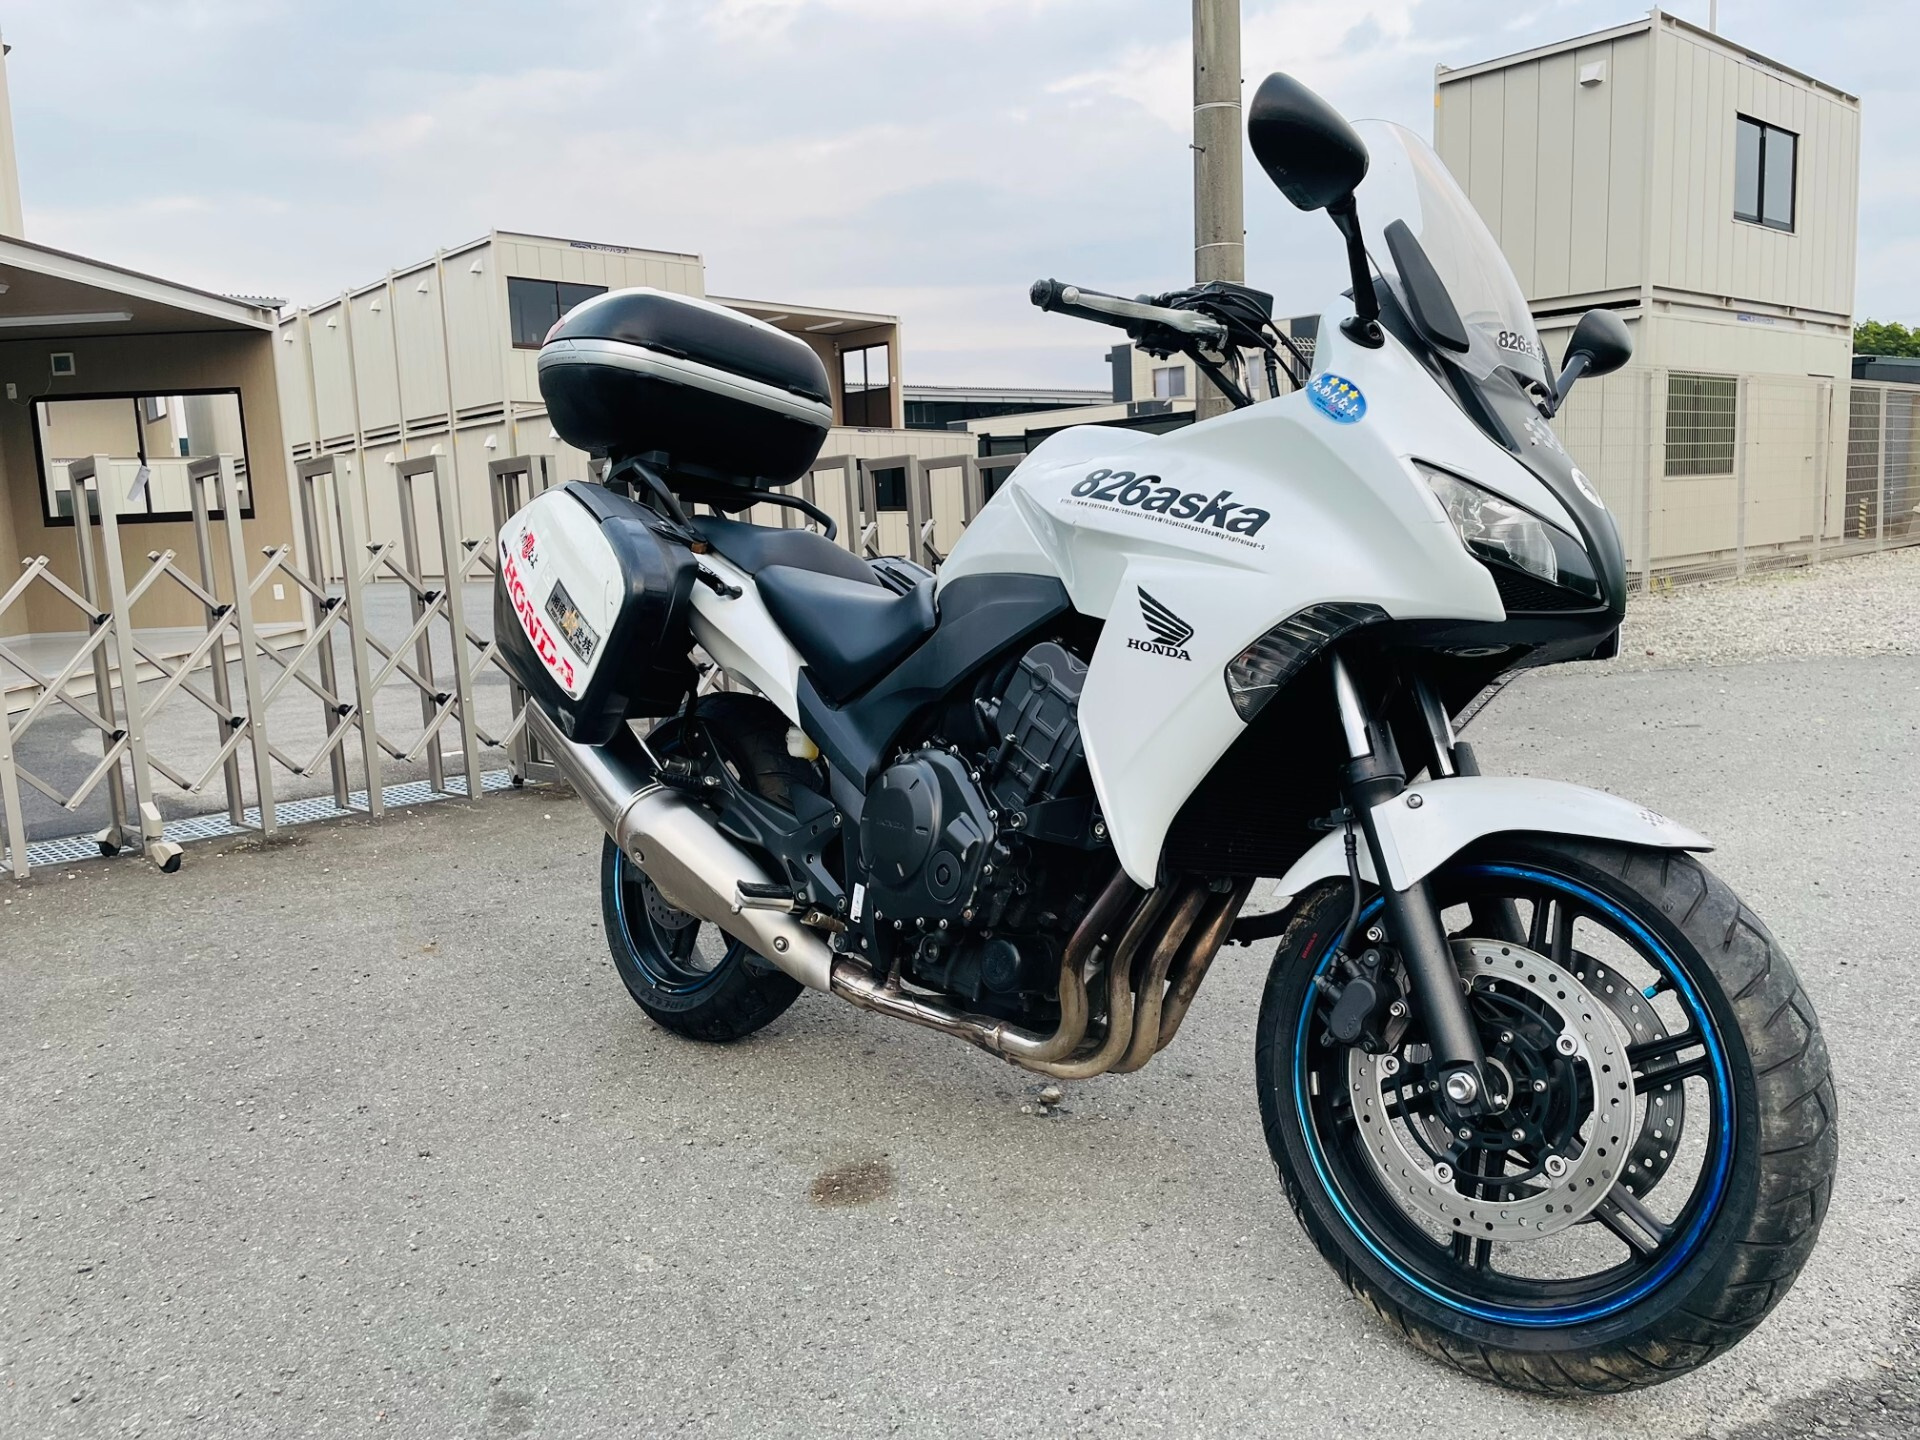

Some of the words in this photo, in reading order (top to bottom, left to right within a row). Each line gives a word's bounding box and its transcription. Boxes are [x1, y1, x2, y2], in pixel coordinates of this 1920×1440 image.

[1313, 379, 1358, 417] なめんなよ
[1071, 469, 1270, 537] 826aska
[1127, 638, 1192, 661] HONDA
